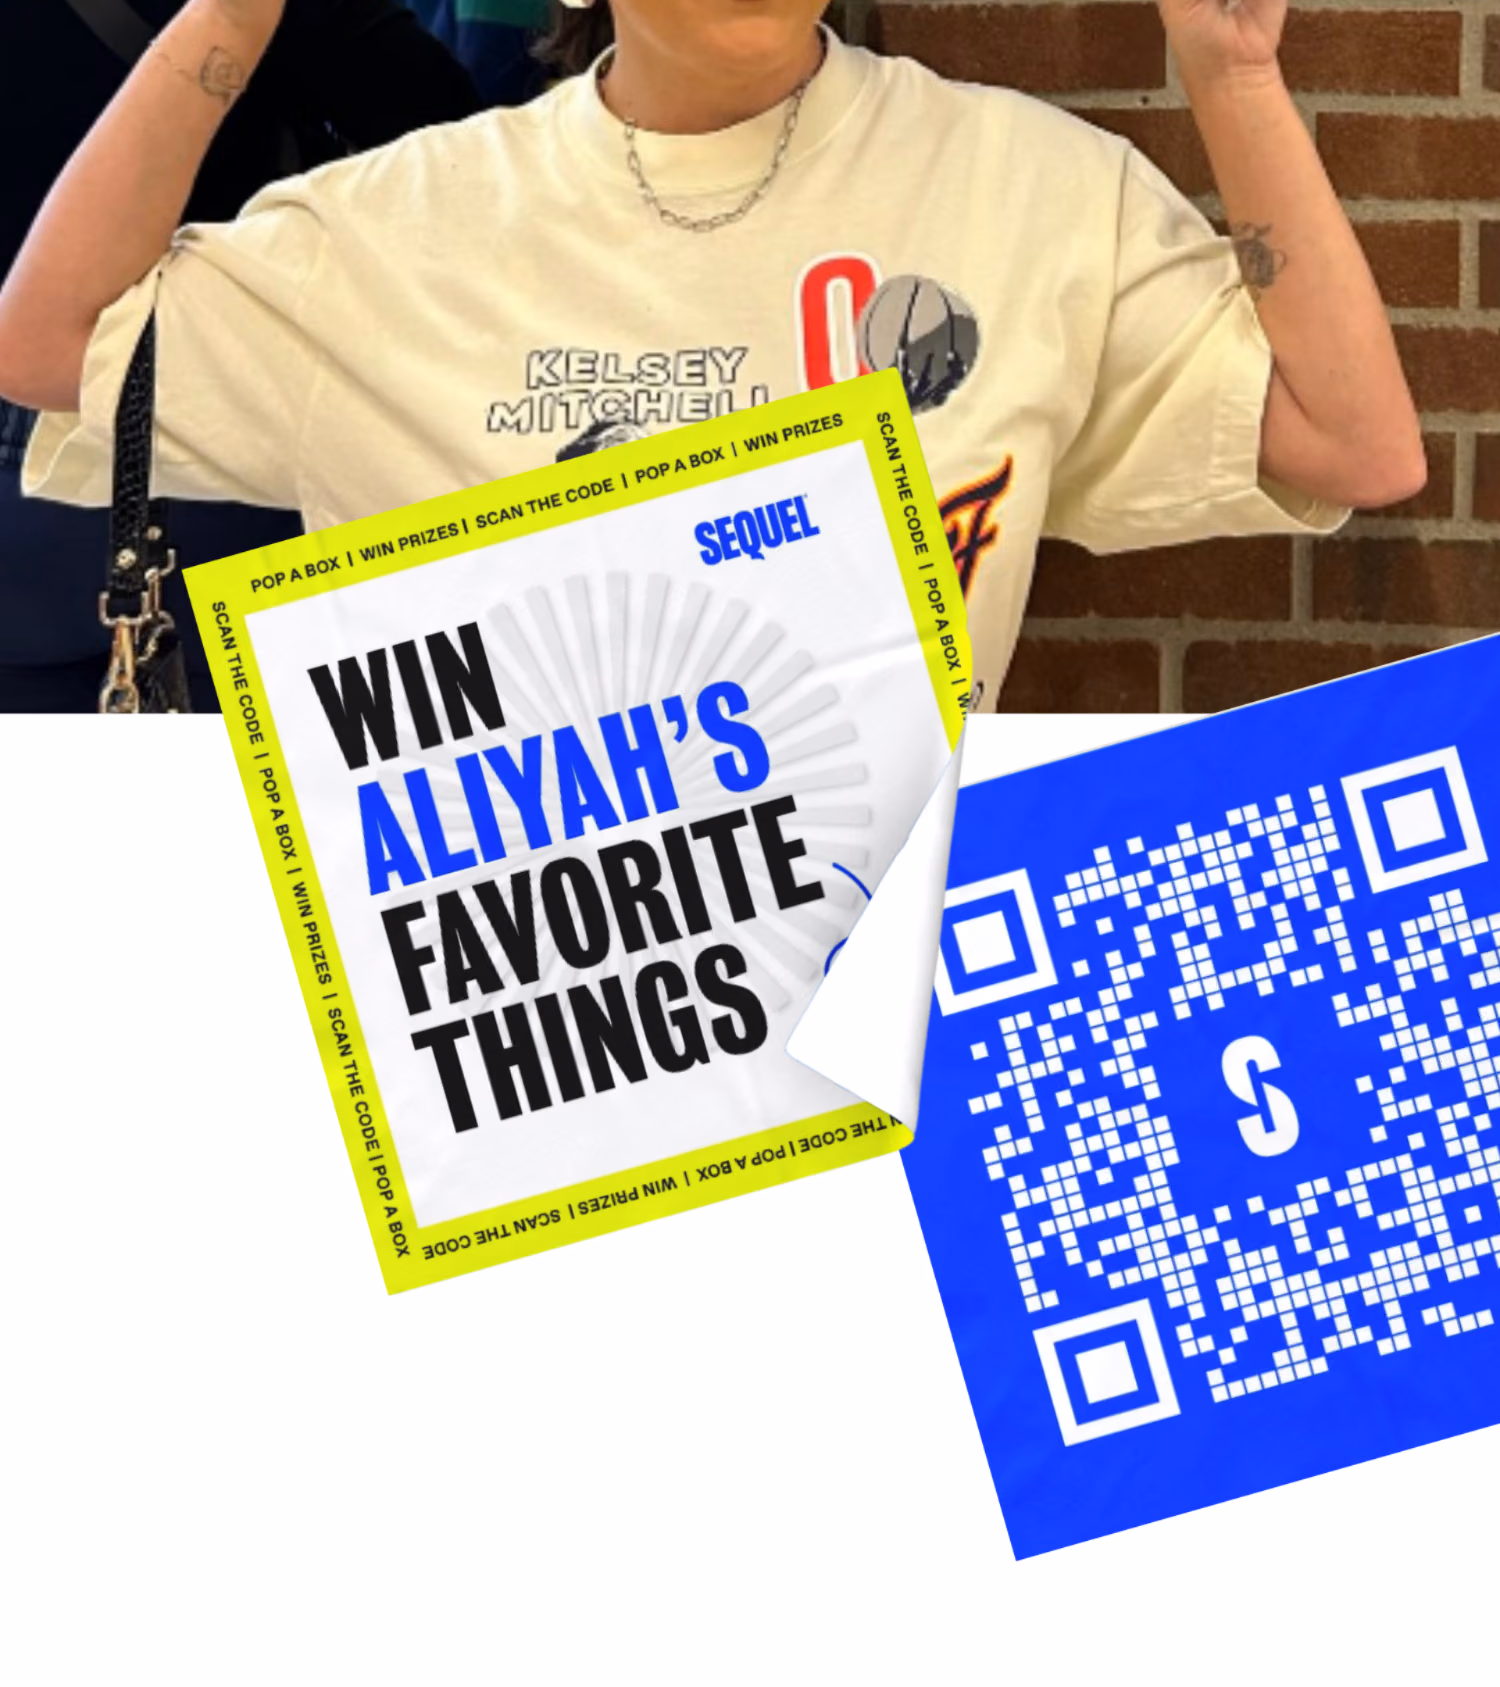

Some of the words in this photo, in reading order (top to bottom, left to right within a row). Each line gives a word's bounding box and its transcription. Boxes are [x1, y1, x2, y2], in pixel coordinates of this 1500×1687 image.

[526, 346, 749, 391] KELSEY
[877, 412, 901, 461] SCAN
[893, 463, 913, 500] THE
[251, 572, 285, 592] POP
[291, 568, 302, 581] A
[305, 556, 340, 577] BOX
[359, 541, 394, 561] WIN
[398, 522, 458, 550] PRIZES
[476, 504, 523, 528] SCAN
[526, 493, 562, 513] THE
[565, 478, 614, 502] CODE
[635, 462, 670, 483] POP
[675, 459, 686, 472] A
[689, 447, 724, 468] BOX
[744, 432, 778, 451] WIN
[782, 413, 843, 441] PRIZES
[694, 493, 821, 568] SEQUEL
[904, 505, 928, 555] CODE
[924, 578, 945, 613] POP
[935, 619, 949, 631] A
[940, 634, 961, 670] BOX
[307, 621, 507, 771] WIN
[356, 679, 772, 896] ALIYAH'S
[379, 793, 825, 1017] FAVORITE
[410, 943, 769, 1134] THINGS
[798, 1128, 847, 1152] CODE
[850, 1117, 887, 1137] THE
[696, 1160, 732, 1181] BOX
[734, 1156, 746, 1169] A
[751, 1145, 786, 1165] POP
[577, 1187, 639, 1215] PRIZES
[642, 1177, 677, 1196] WIN
[474, 1224, 511, 1244] THE
[513, 1209, 560, 1233] SCAN
[422, 1235, 471, 1259] CODE
